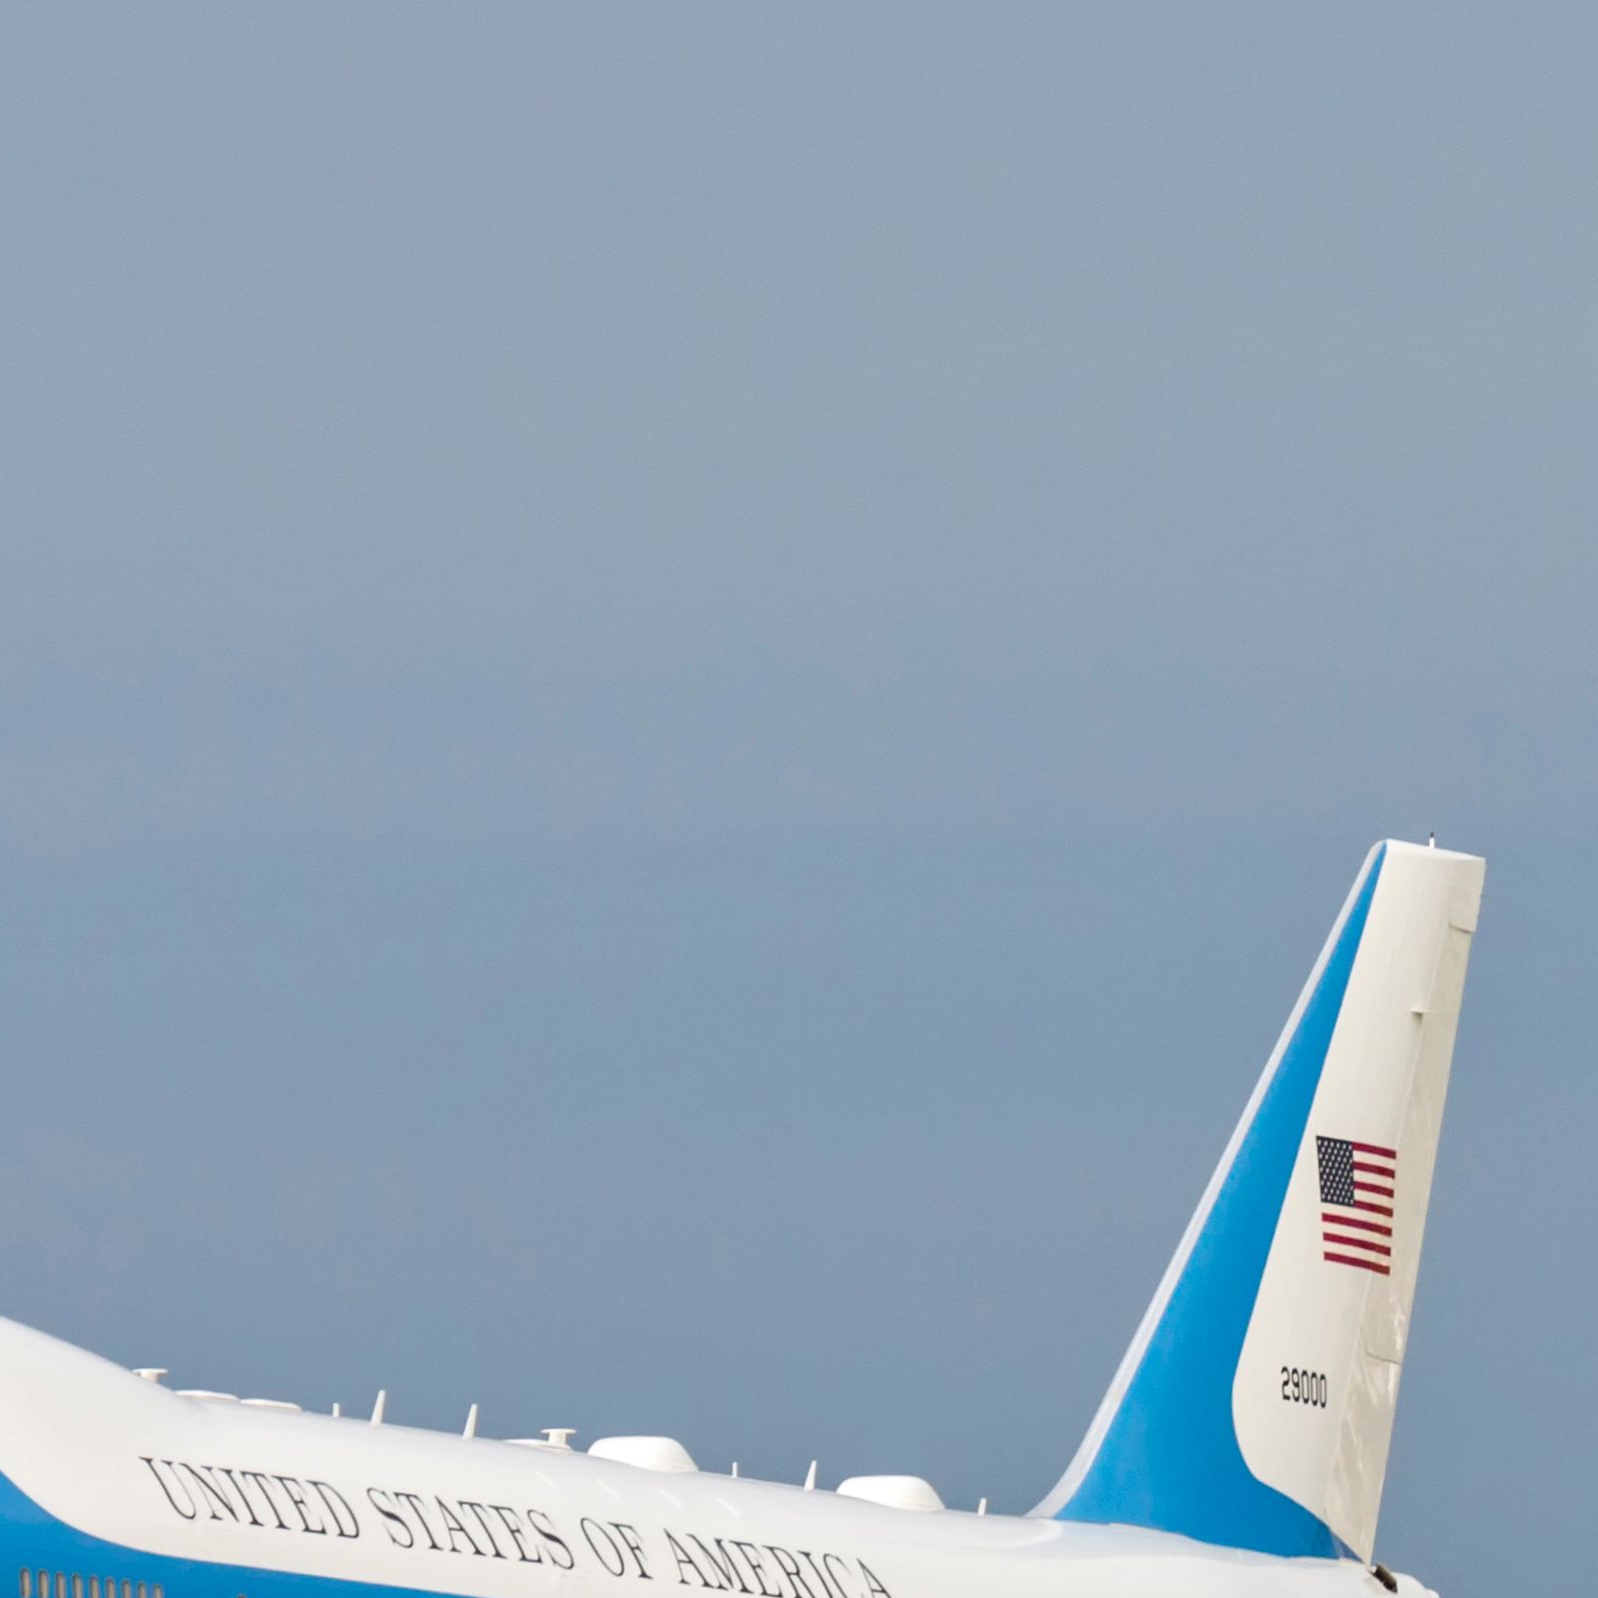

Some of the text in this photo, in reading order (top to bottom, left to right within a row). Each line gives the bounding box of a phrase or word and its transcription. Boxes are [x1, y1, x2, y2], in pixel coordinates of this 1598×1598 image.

[1280, 1366, 1328, 1409] 29000
[139, 1456, 360, 1540] UNITED
[364, 1486, 577, 1572] STATES
[579, 1516, 655, 1582] OF
